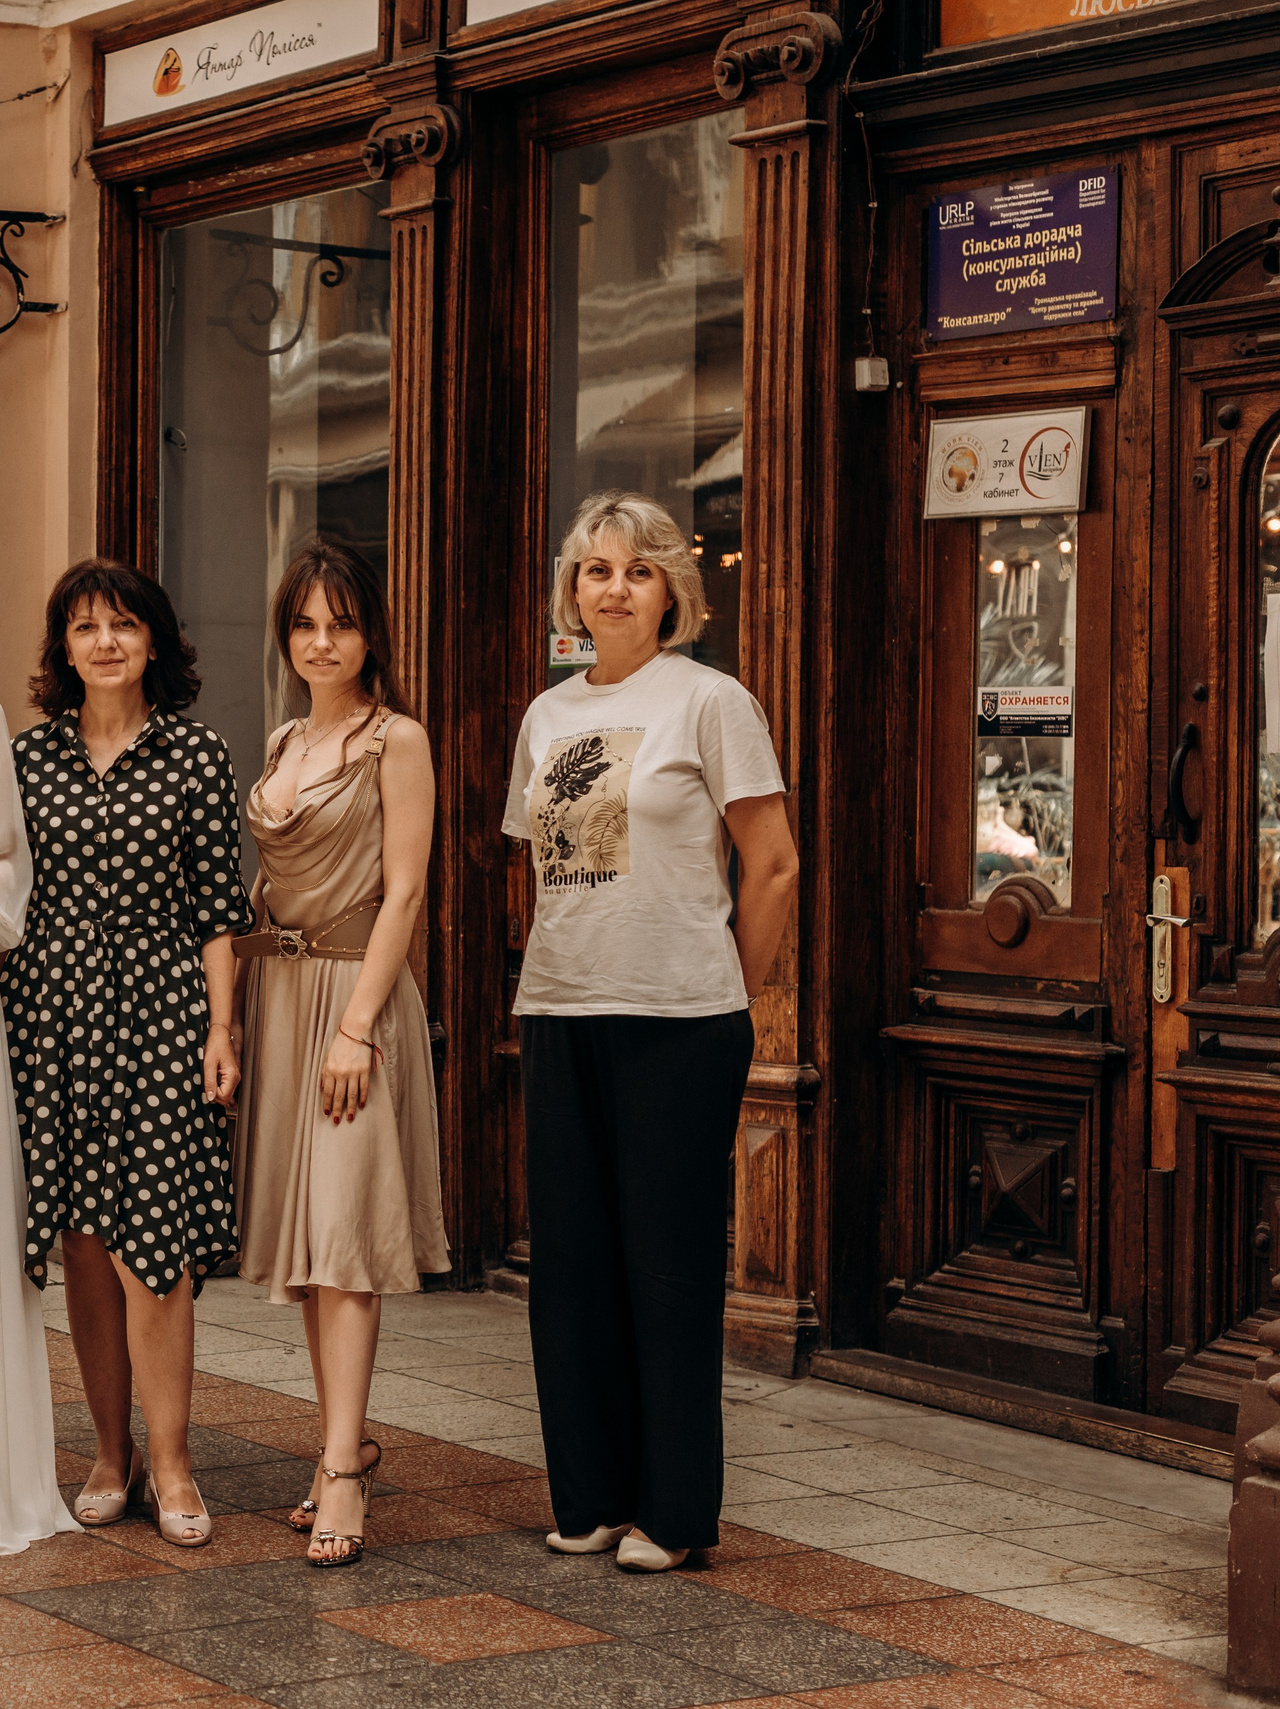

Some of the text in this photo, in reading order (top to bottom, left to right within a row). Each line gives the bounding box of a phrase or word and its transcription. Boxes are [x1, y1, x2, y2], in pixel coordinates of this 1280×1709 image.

[1079, 176, 1106, 191] DFID
[1079, 193, 1106, 202] International
[1079, 199, 1106, 209] Development
[938, 200, 975, 225] URLP
[962, 223, 1083, 257] Сільська дорадча
[962, 241, 1082, 282] (консультаційна)
[995, 269, 1047, 294] служба
[1001, 439, 1009, 453] 2
[992, 458, 1015, 469] этаж
[998, 473, 1004, 483] 7
[983, 487, 1020, 499] кабинет
[579, 639, 597, 652] VIS
[999, 696, 1069, 706] ОХРАНЯЕТСЯ
[543, 866, 618, 889] Boutique
